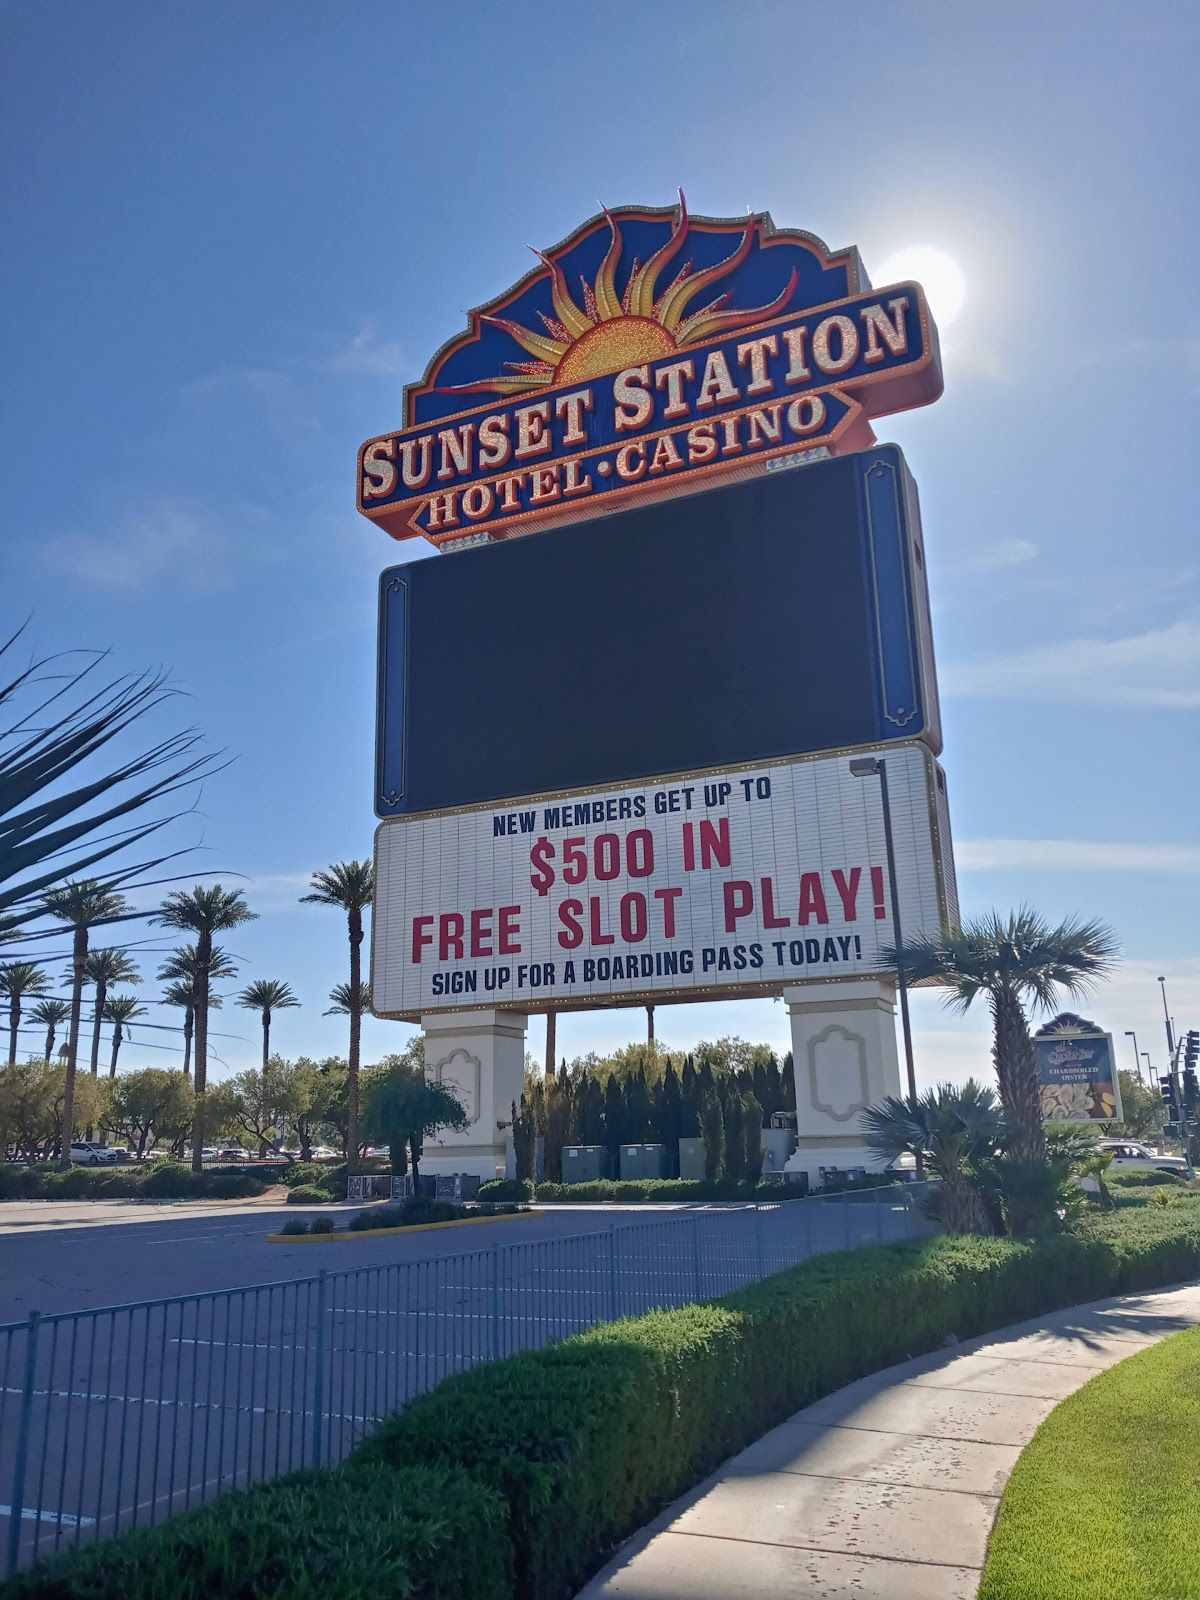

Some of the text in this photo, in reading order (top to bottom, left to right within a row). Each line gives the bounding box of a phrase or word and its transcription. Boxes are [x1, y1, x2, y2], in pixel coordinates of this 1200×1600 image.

[363, 296, 909, 498] SUNSET STATION
[426, 394, 826, 531] HOTEL CASINO
[493, 776, 771, 837] NEW MEMBERS GET UP TO
[530, 817, 731, 897] $500 IN
[412, 866, 886, 963] FREE SLOT PLAY!
[432, 935, 863, 996] SIGN UP FOR A BOARDING PASS TODAY!
